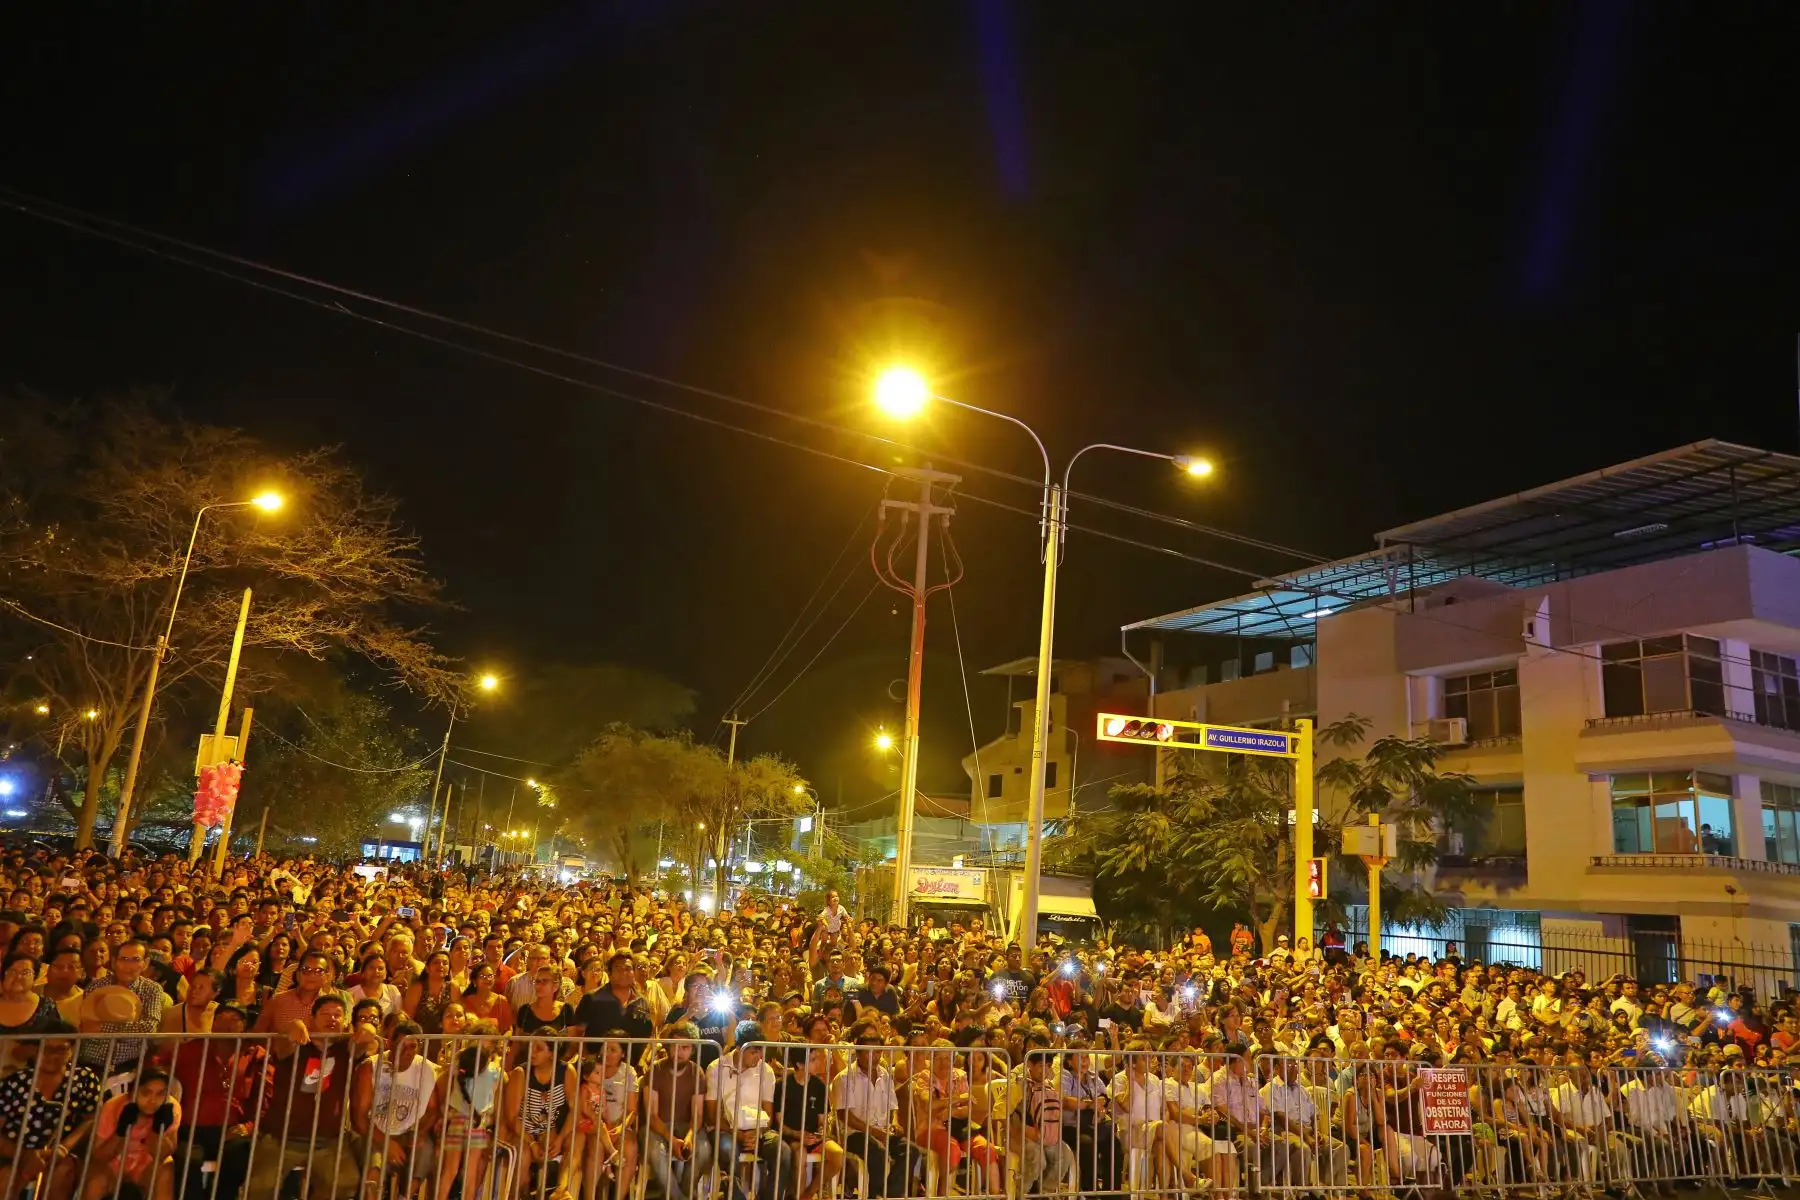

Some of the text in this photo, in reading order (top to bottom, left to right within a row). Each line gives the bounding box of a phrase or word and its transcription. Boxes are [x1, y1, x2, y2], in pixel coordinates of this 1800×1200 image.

[1208, 734, 1285, 747] AV. GUILLERMO IRAZOLA
[1431, 1074, 1465, 1083] RESPETO
[1426, 1106, 1470, 1118] OBSTETRAS
[1433, 1119, 1468, 1129] AHORA
